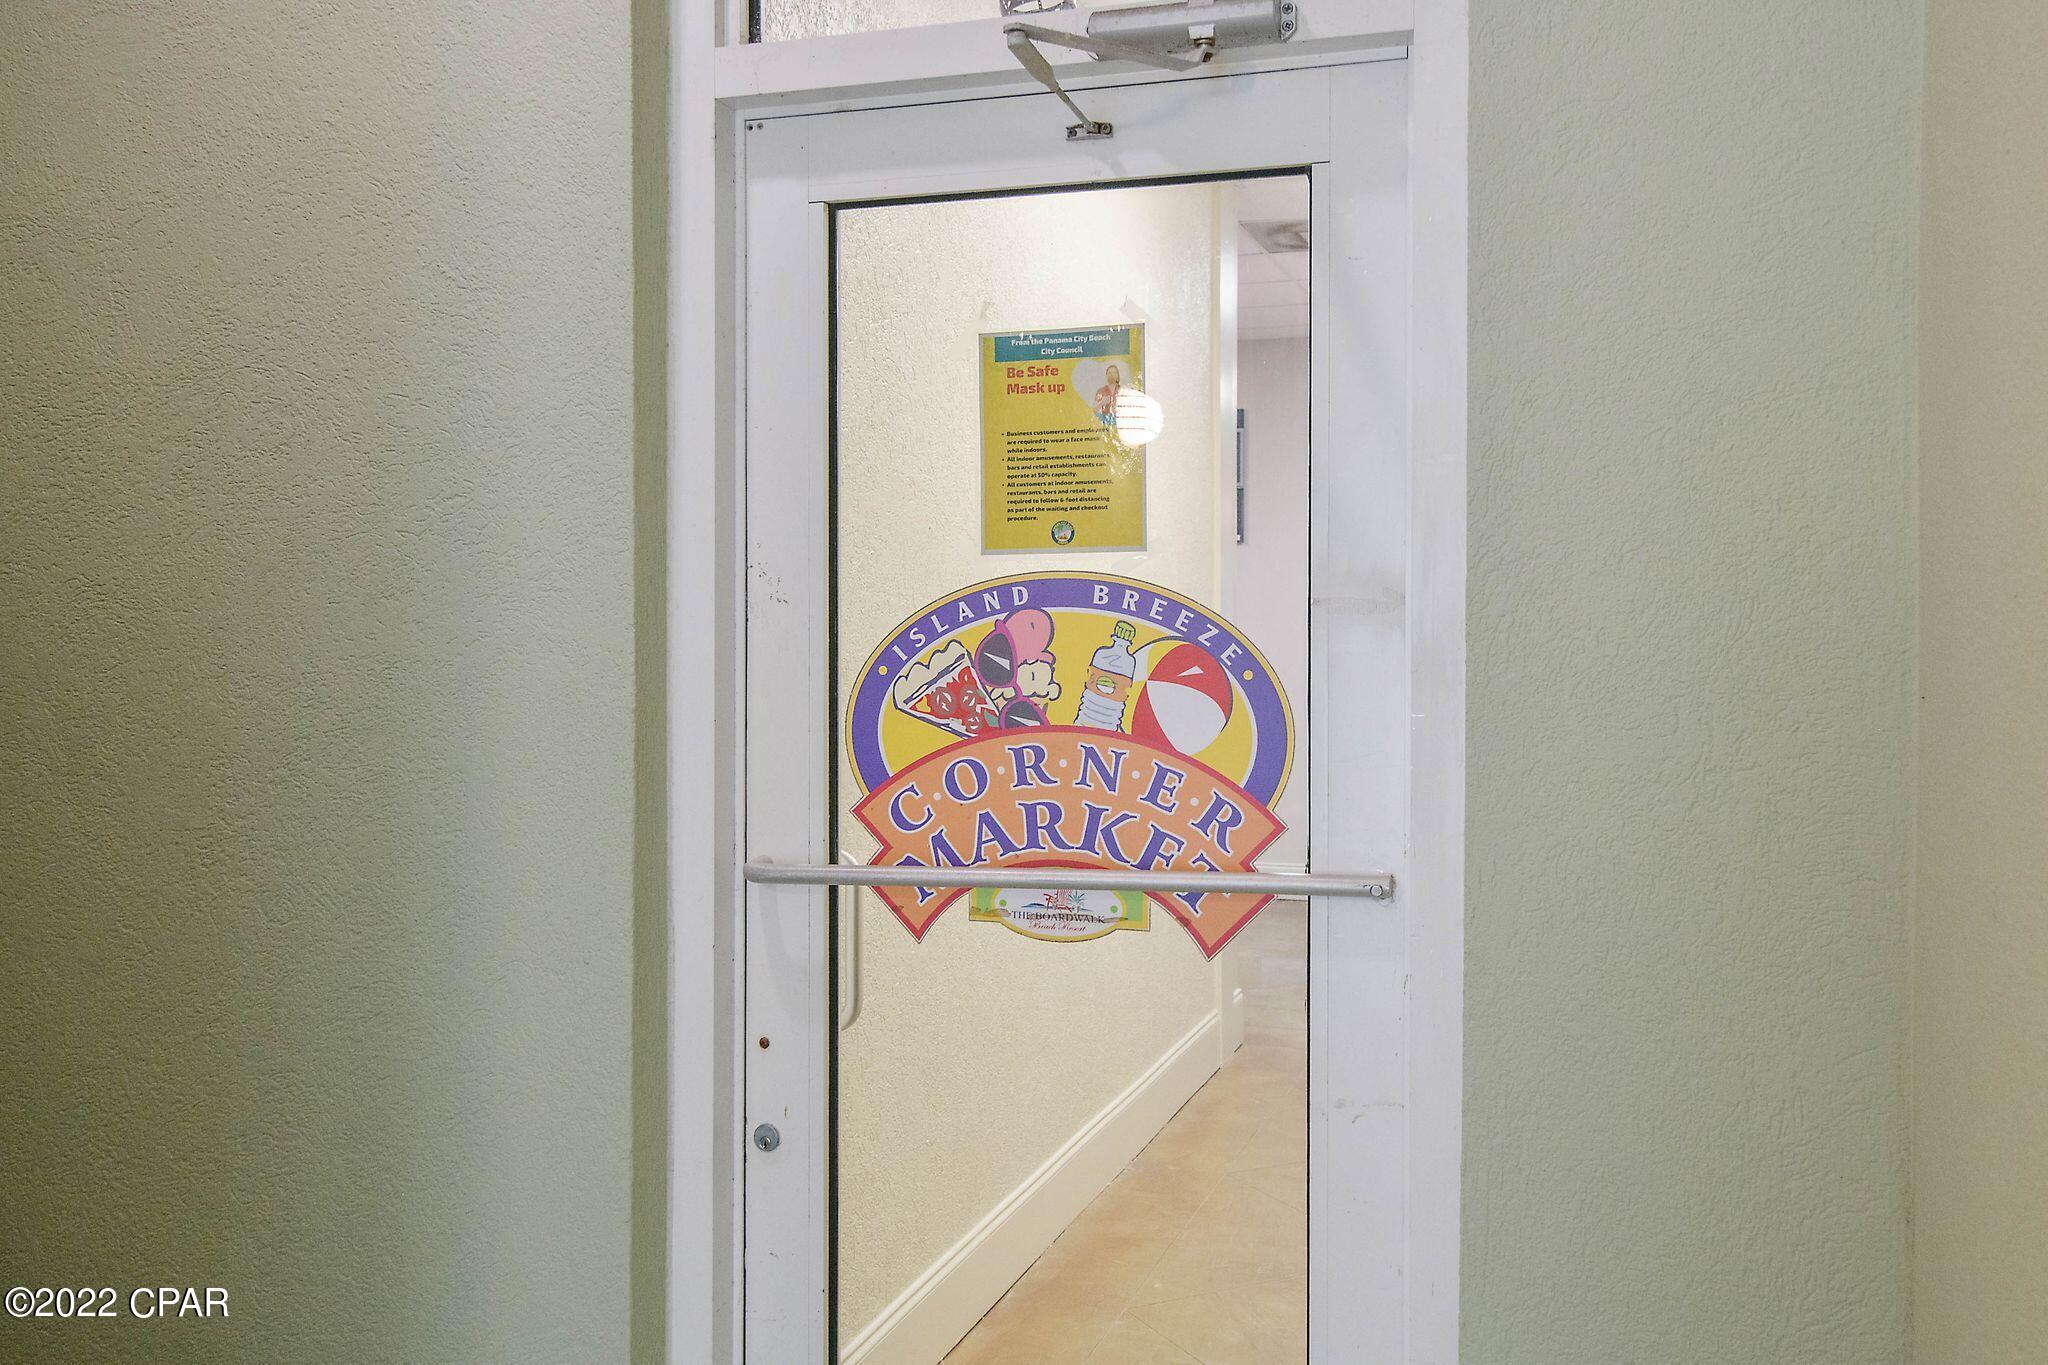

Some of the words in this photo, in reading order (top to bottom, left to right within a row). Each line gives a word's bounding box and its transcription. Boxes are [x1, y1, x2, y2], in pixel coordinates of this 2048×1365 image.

[1006, 367, 1024, 378] Be
[1027, 366, 1058, 377] Safe
[1006, 382, 1044, 394] Mask
[1048, 384, 1066, 394] up
[890, 585, 1030, 662] ISLAND
[1092, 584, 1243, 666] BREEZE
[1011, 910, 1030, 920] THE
[1036, 912, 1104, 924] BOARDWALK
